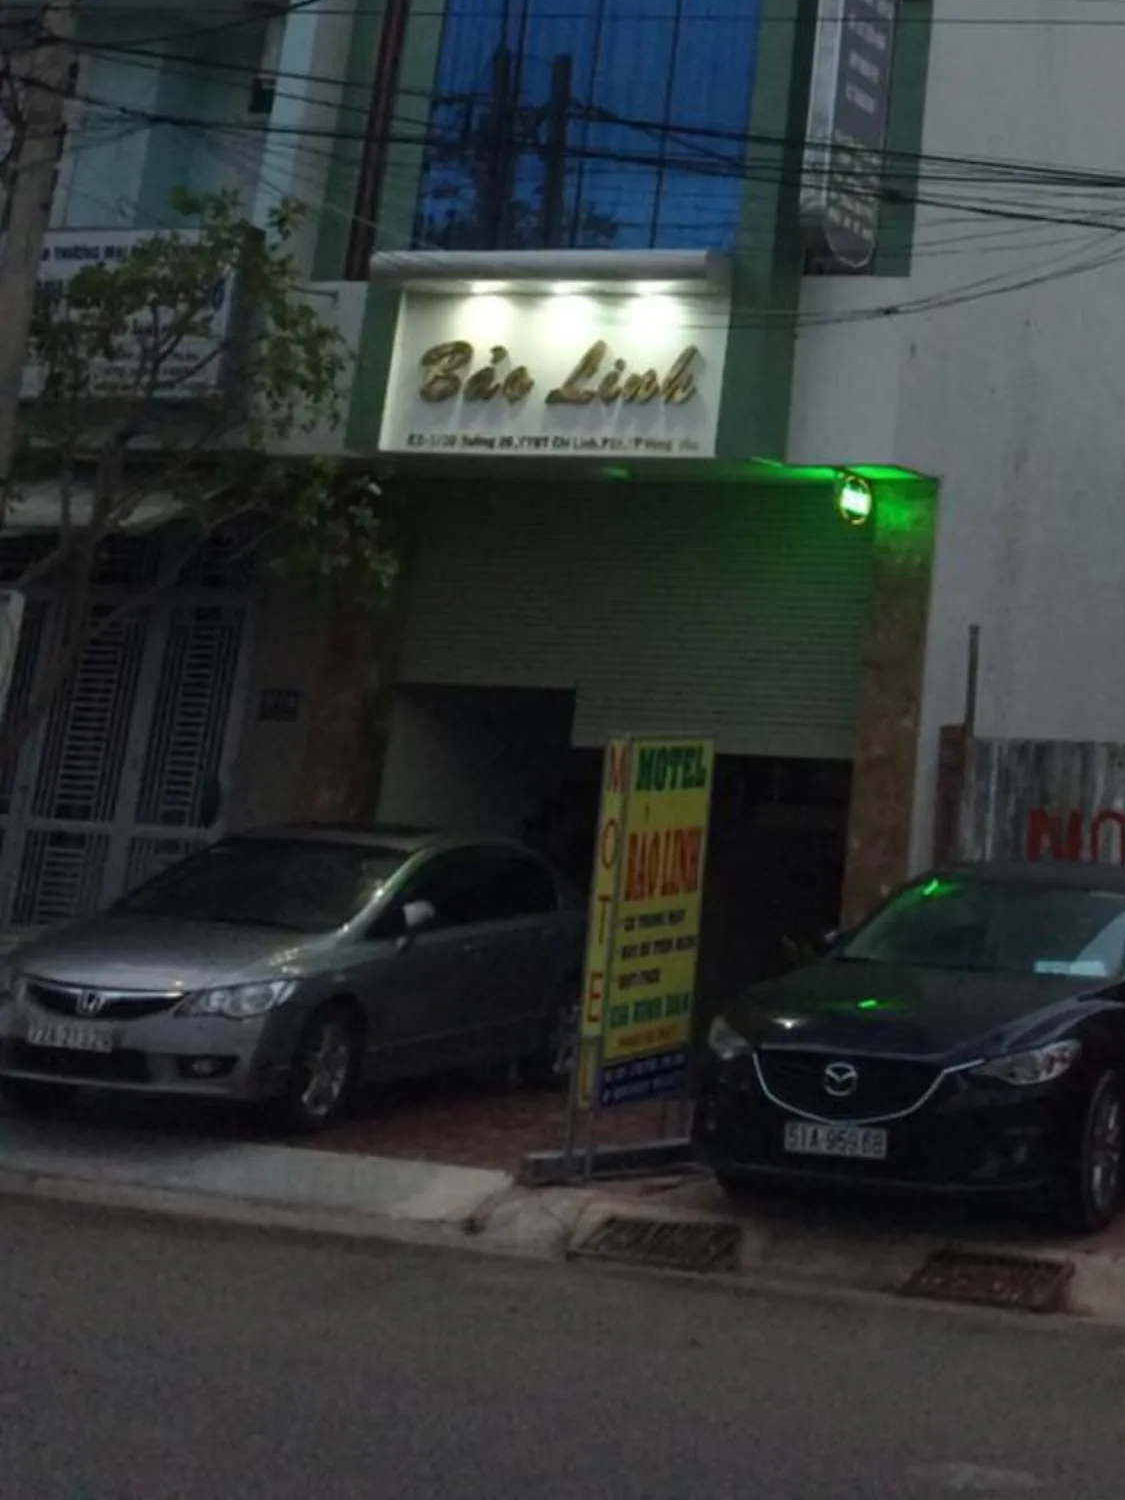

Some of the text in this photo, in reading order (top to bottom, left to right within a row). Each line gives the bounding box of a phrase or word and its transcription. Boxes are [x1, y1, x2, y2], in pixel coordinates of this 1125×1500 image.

[418, 338, 701, 405] Bảo Linh
[635, 744, 708, 791] MOTEL
